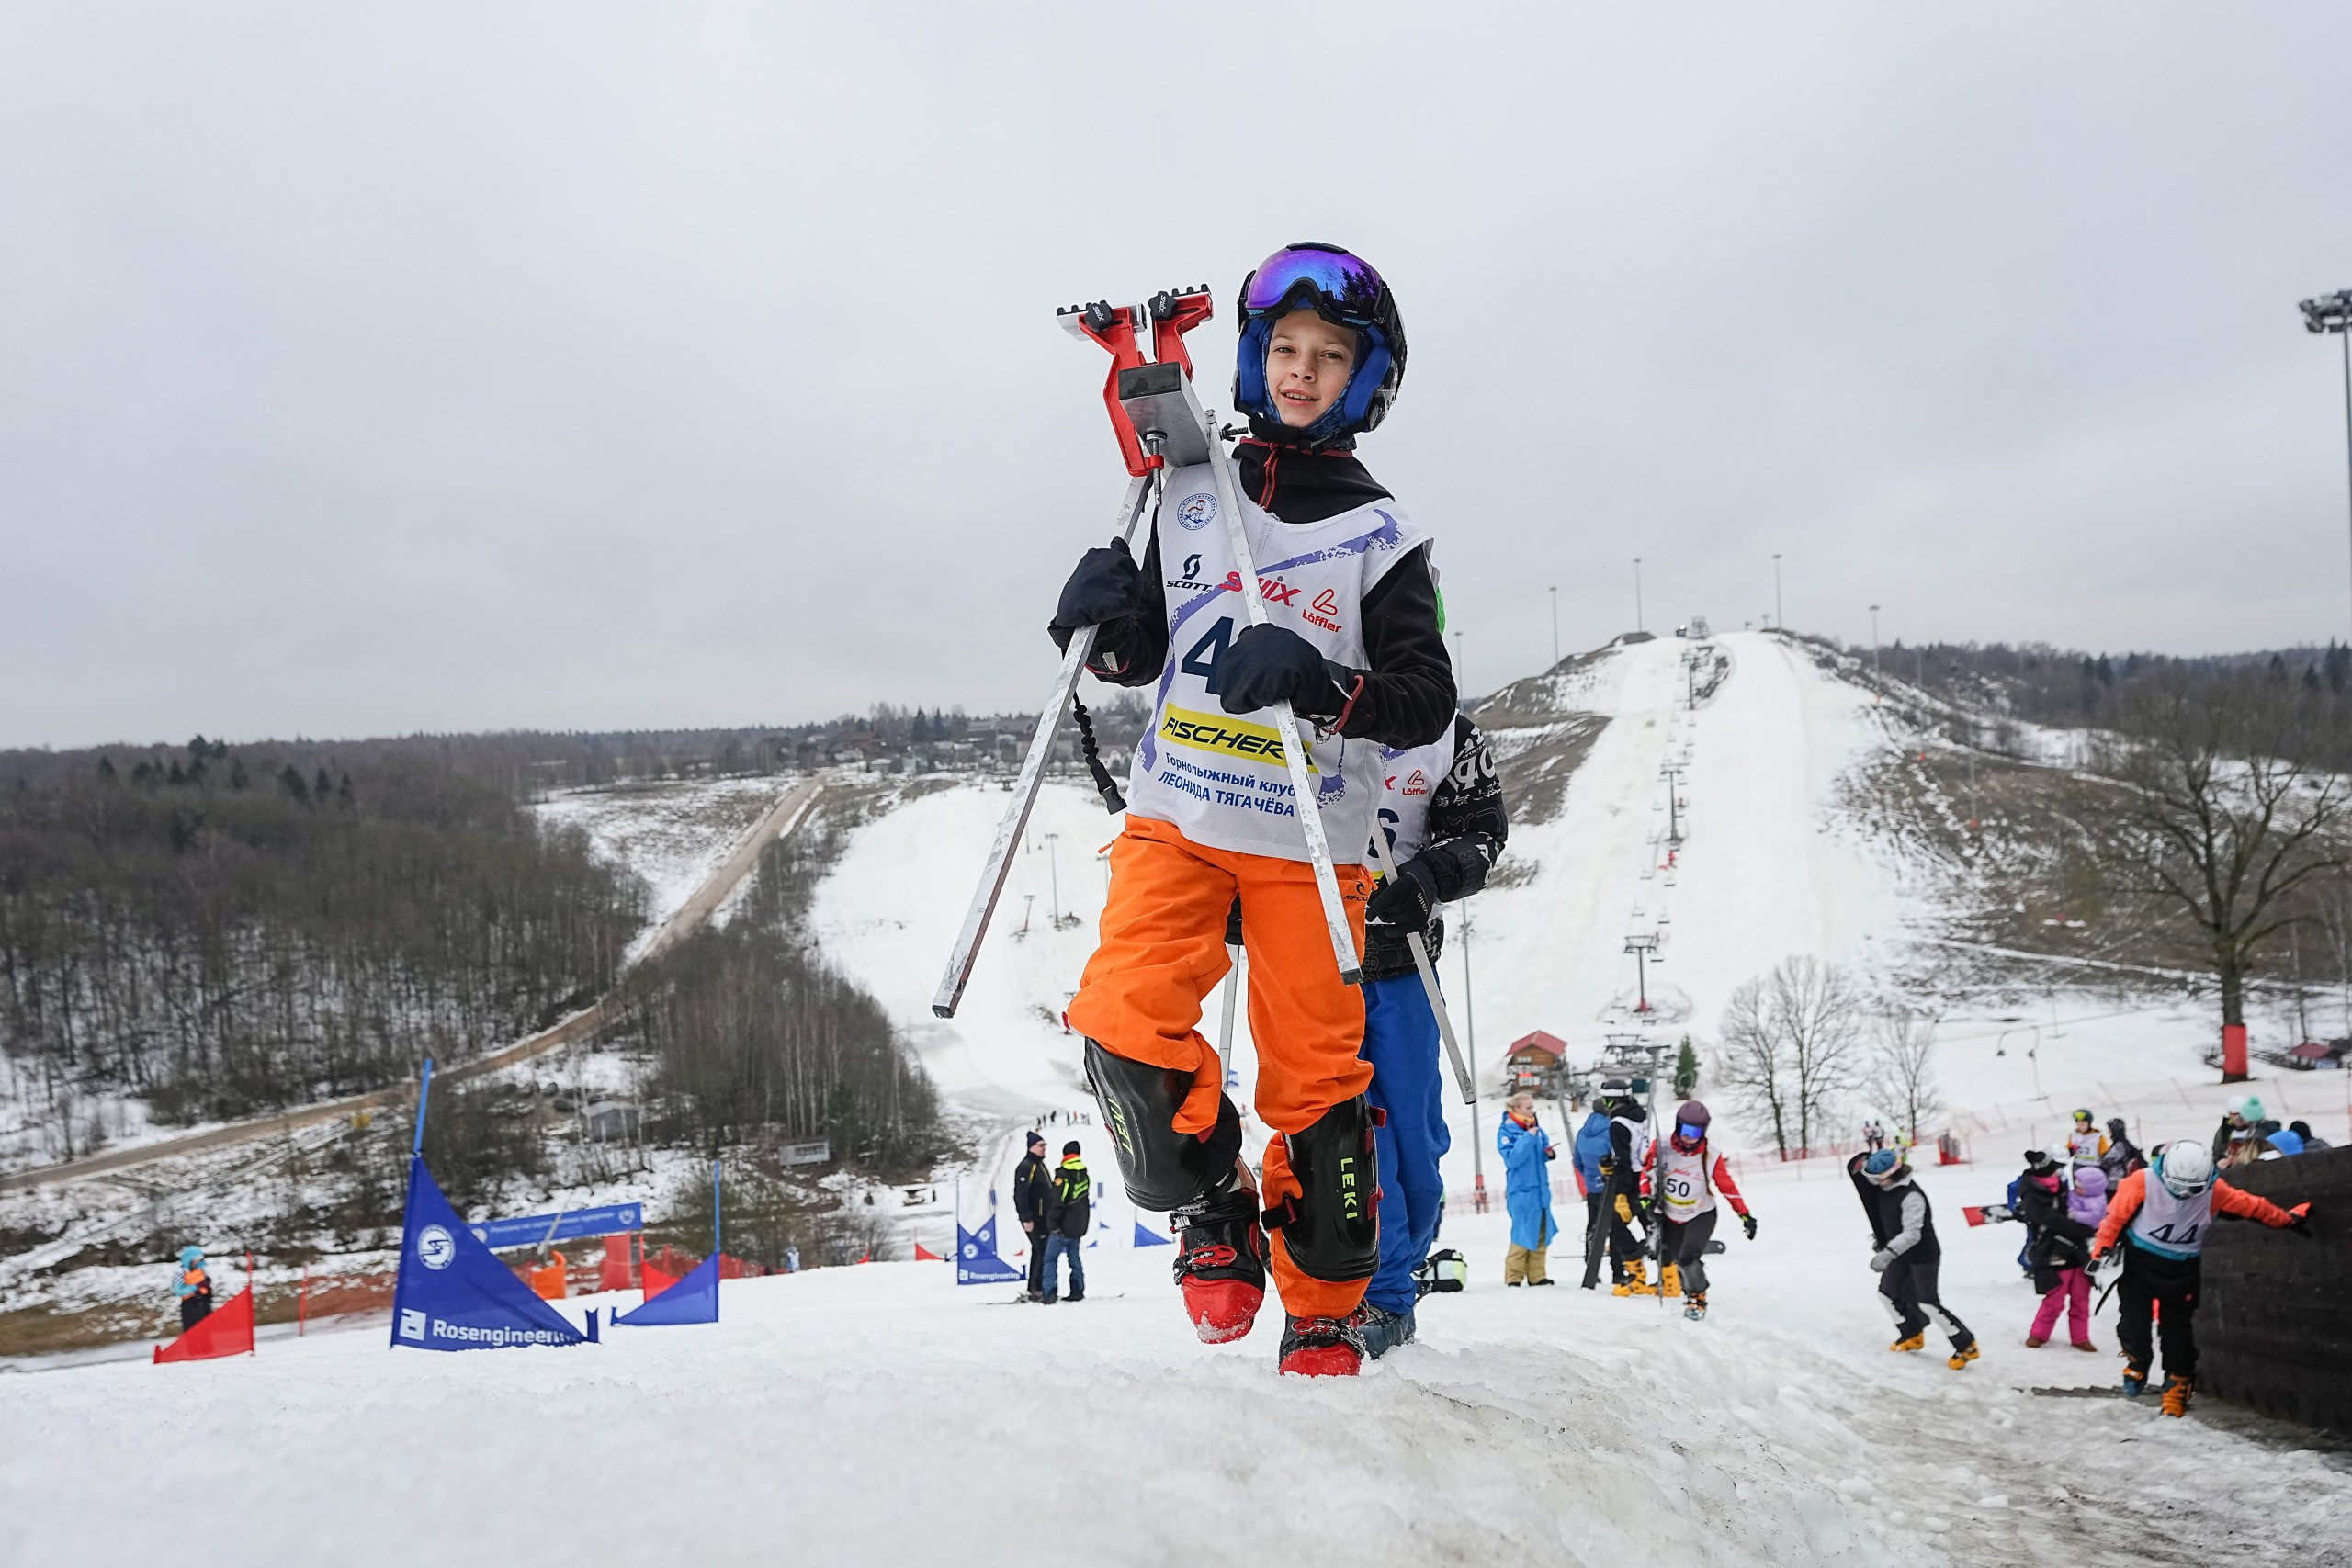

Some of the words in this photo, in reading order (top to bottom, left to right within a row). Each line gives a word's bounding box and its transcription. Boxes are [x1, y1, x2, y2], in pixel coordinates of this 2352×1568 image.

[1166, 580, 1213, 592] SCOTT
[1302, 608, 1342, 633] Löffler
[1162, 716, 1284, 761] FISCHER
[1165, 751, 1256, 787] Горнолыжный
[1259, 780, 1296, 798] клуб
[1158, 771, 1211, 802] ЛЕОНИДА
[1216, 789, 1295, 818] ТЯГАЧЁВА
[1107, 1097, 1135, 1157] LEKI
[1340, 1157, 1358, 1220] LEKI
[1666, 1178, 1690, 1198] 50
[2148, 1223, 2199, 1245] 44
[432, 1318, 576, 1347] Rosengineeri
